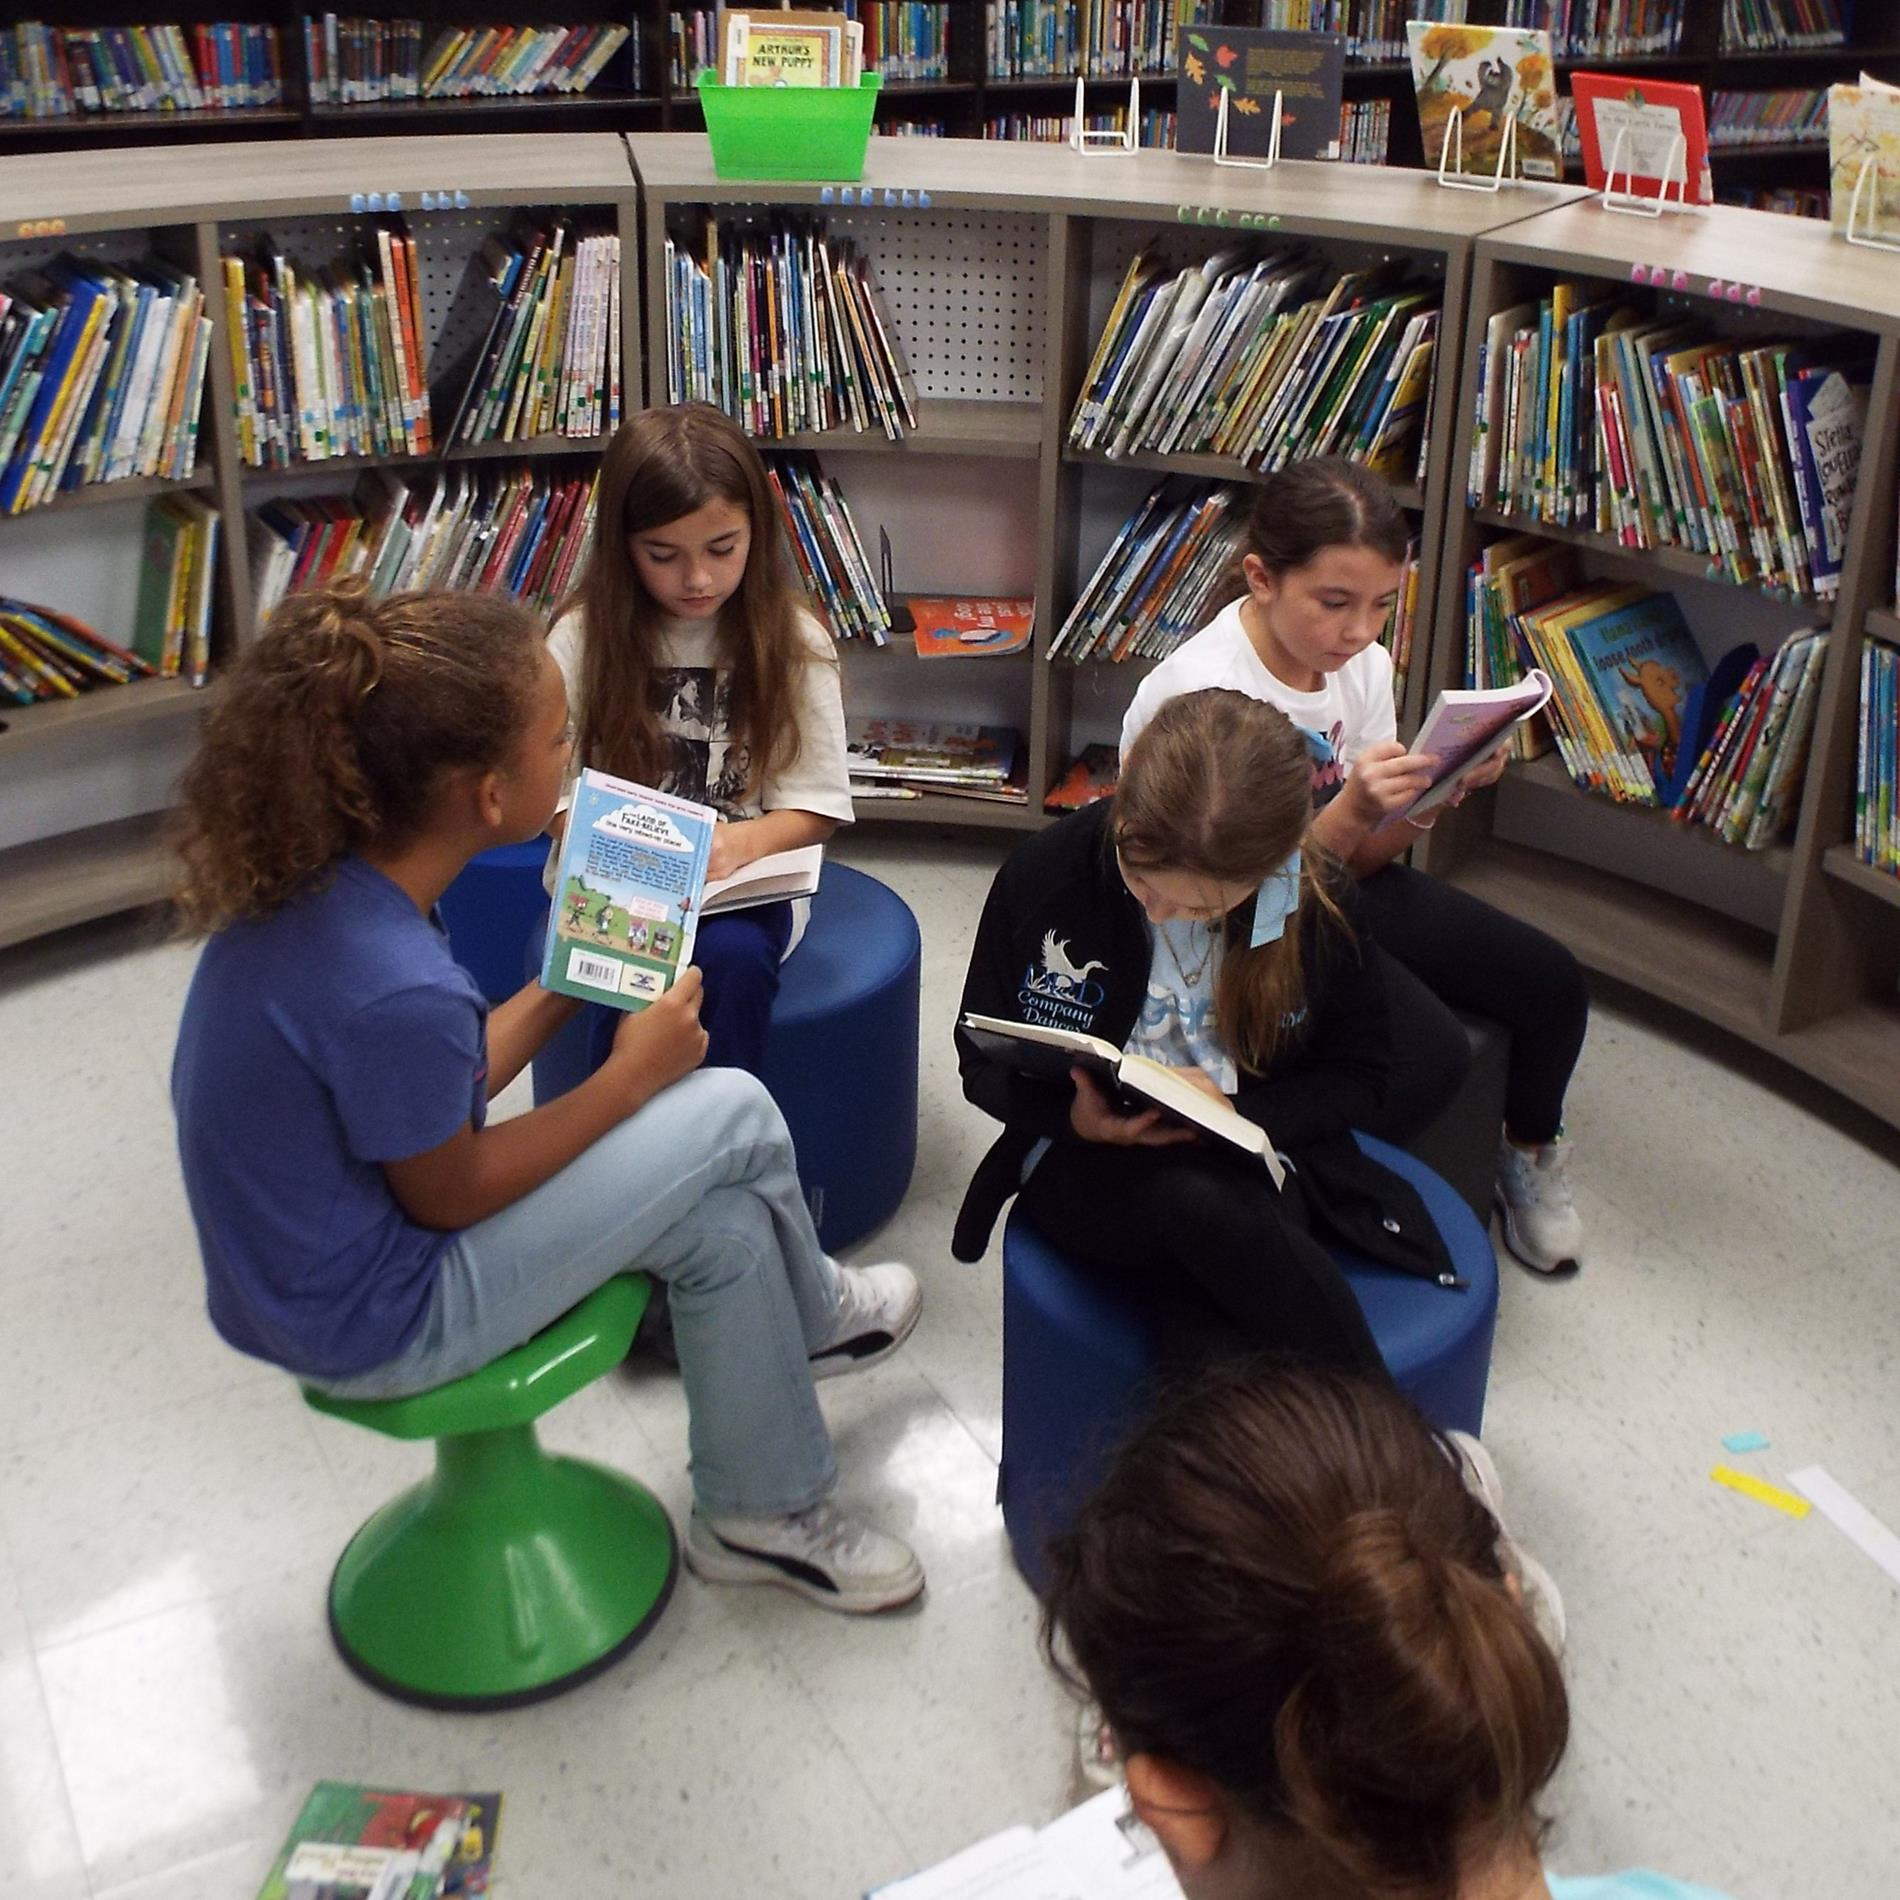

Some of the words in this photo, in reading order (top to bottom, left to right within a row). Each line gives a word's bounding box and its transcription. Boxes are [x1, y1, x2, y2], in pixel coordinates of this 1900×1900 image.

[757, 44, 811, 56] ARTHUR'S
[752, 56, 776, 67] NEW
[781, 56, 815, 68] PUPPY
[637, 813, 656, 825] LAND
[1018, 990, 1093, 1029] Company
